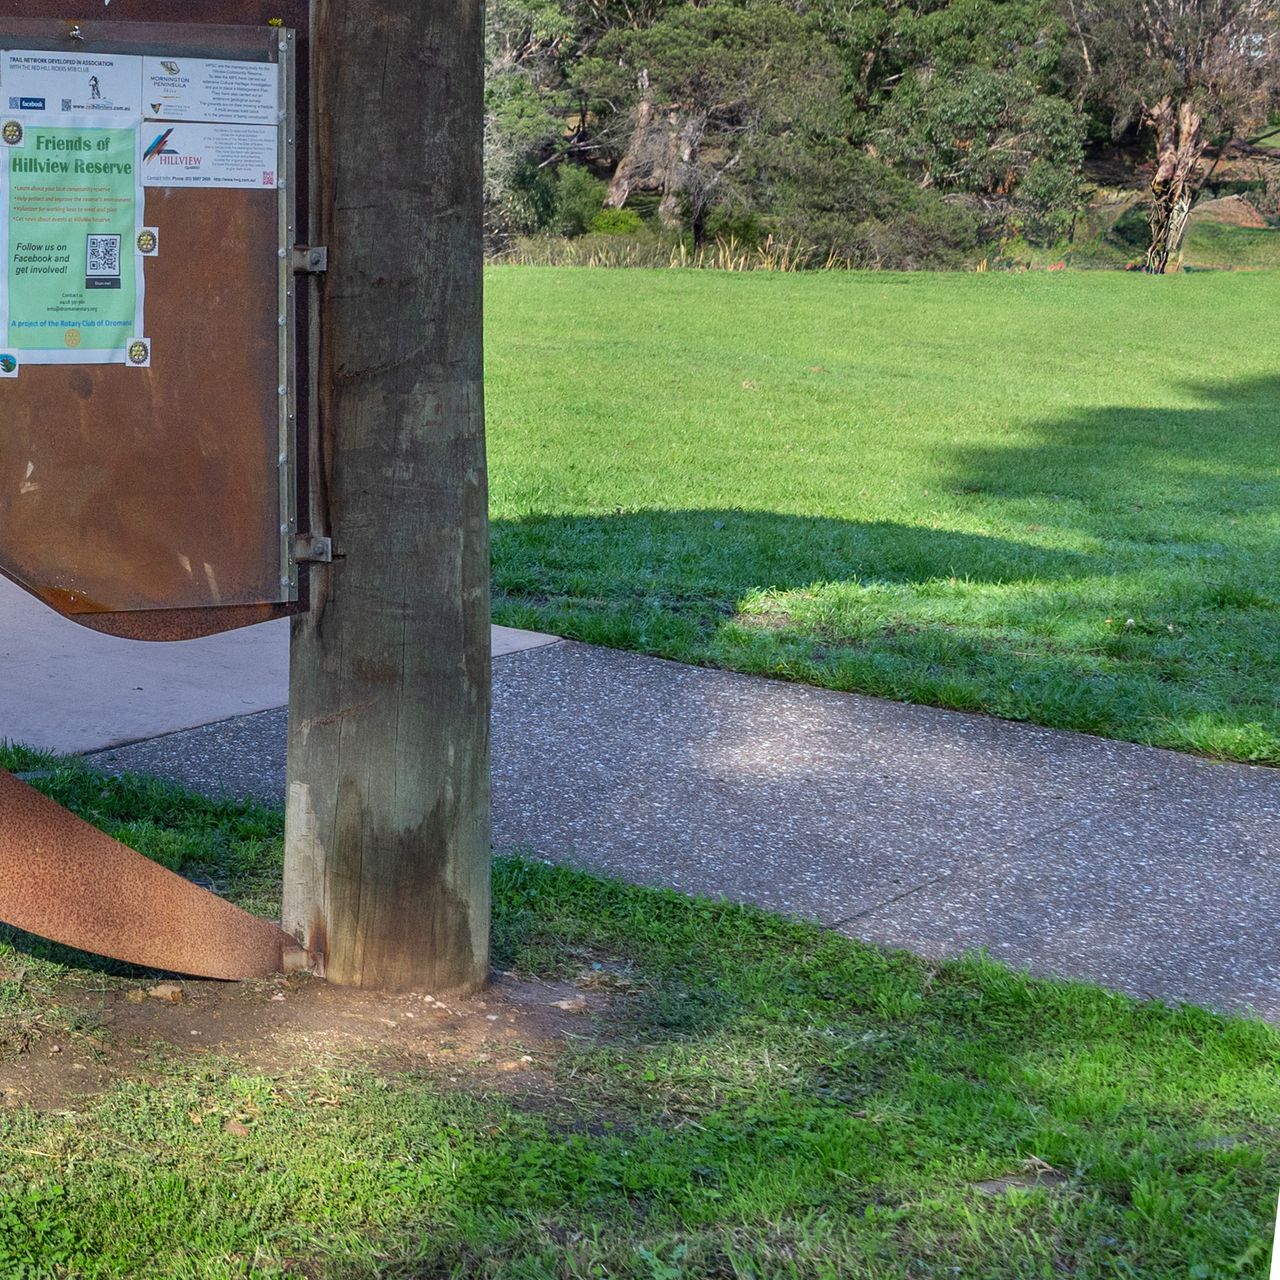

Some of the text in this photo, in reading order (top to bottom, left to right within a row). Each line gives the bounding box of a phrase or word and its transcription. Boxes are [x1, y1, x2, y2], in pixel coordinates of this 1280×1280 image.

[22, 100, 44, 108] facebook
[36, 135, 111, 151] Friends of
[159, 156, 202, 165] HILLVIEW
[12, 157, 71, 173] Hillview
[74, 158, 132, 174] Reserve
[16, 243, 43, 251] Follow
[13, 254, 70, 263] Facebook and
[15, 265, 68, 275] get involved!
[18, 321, 39, 329] project
[60, 321, 81, 329] Rotary
